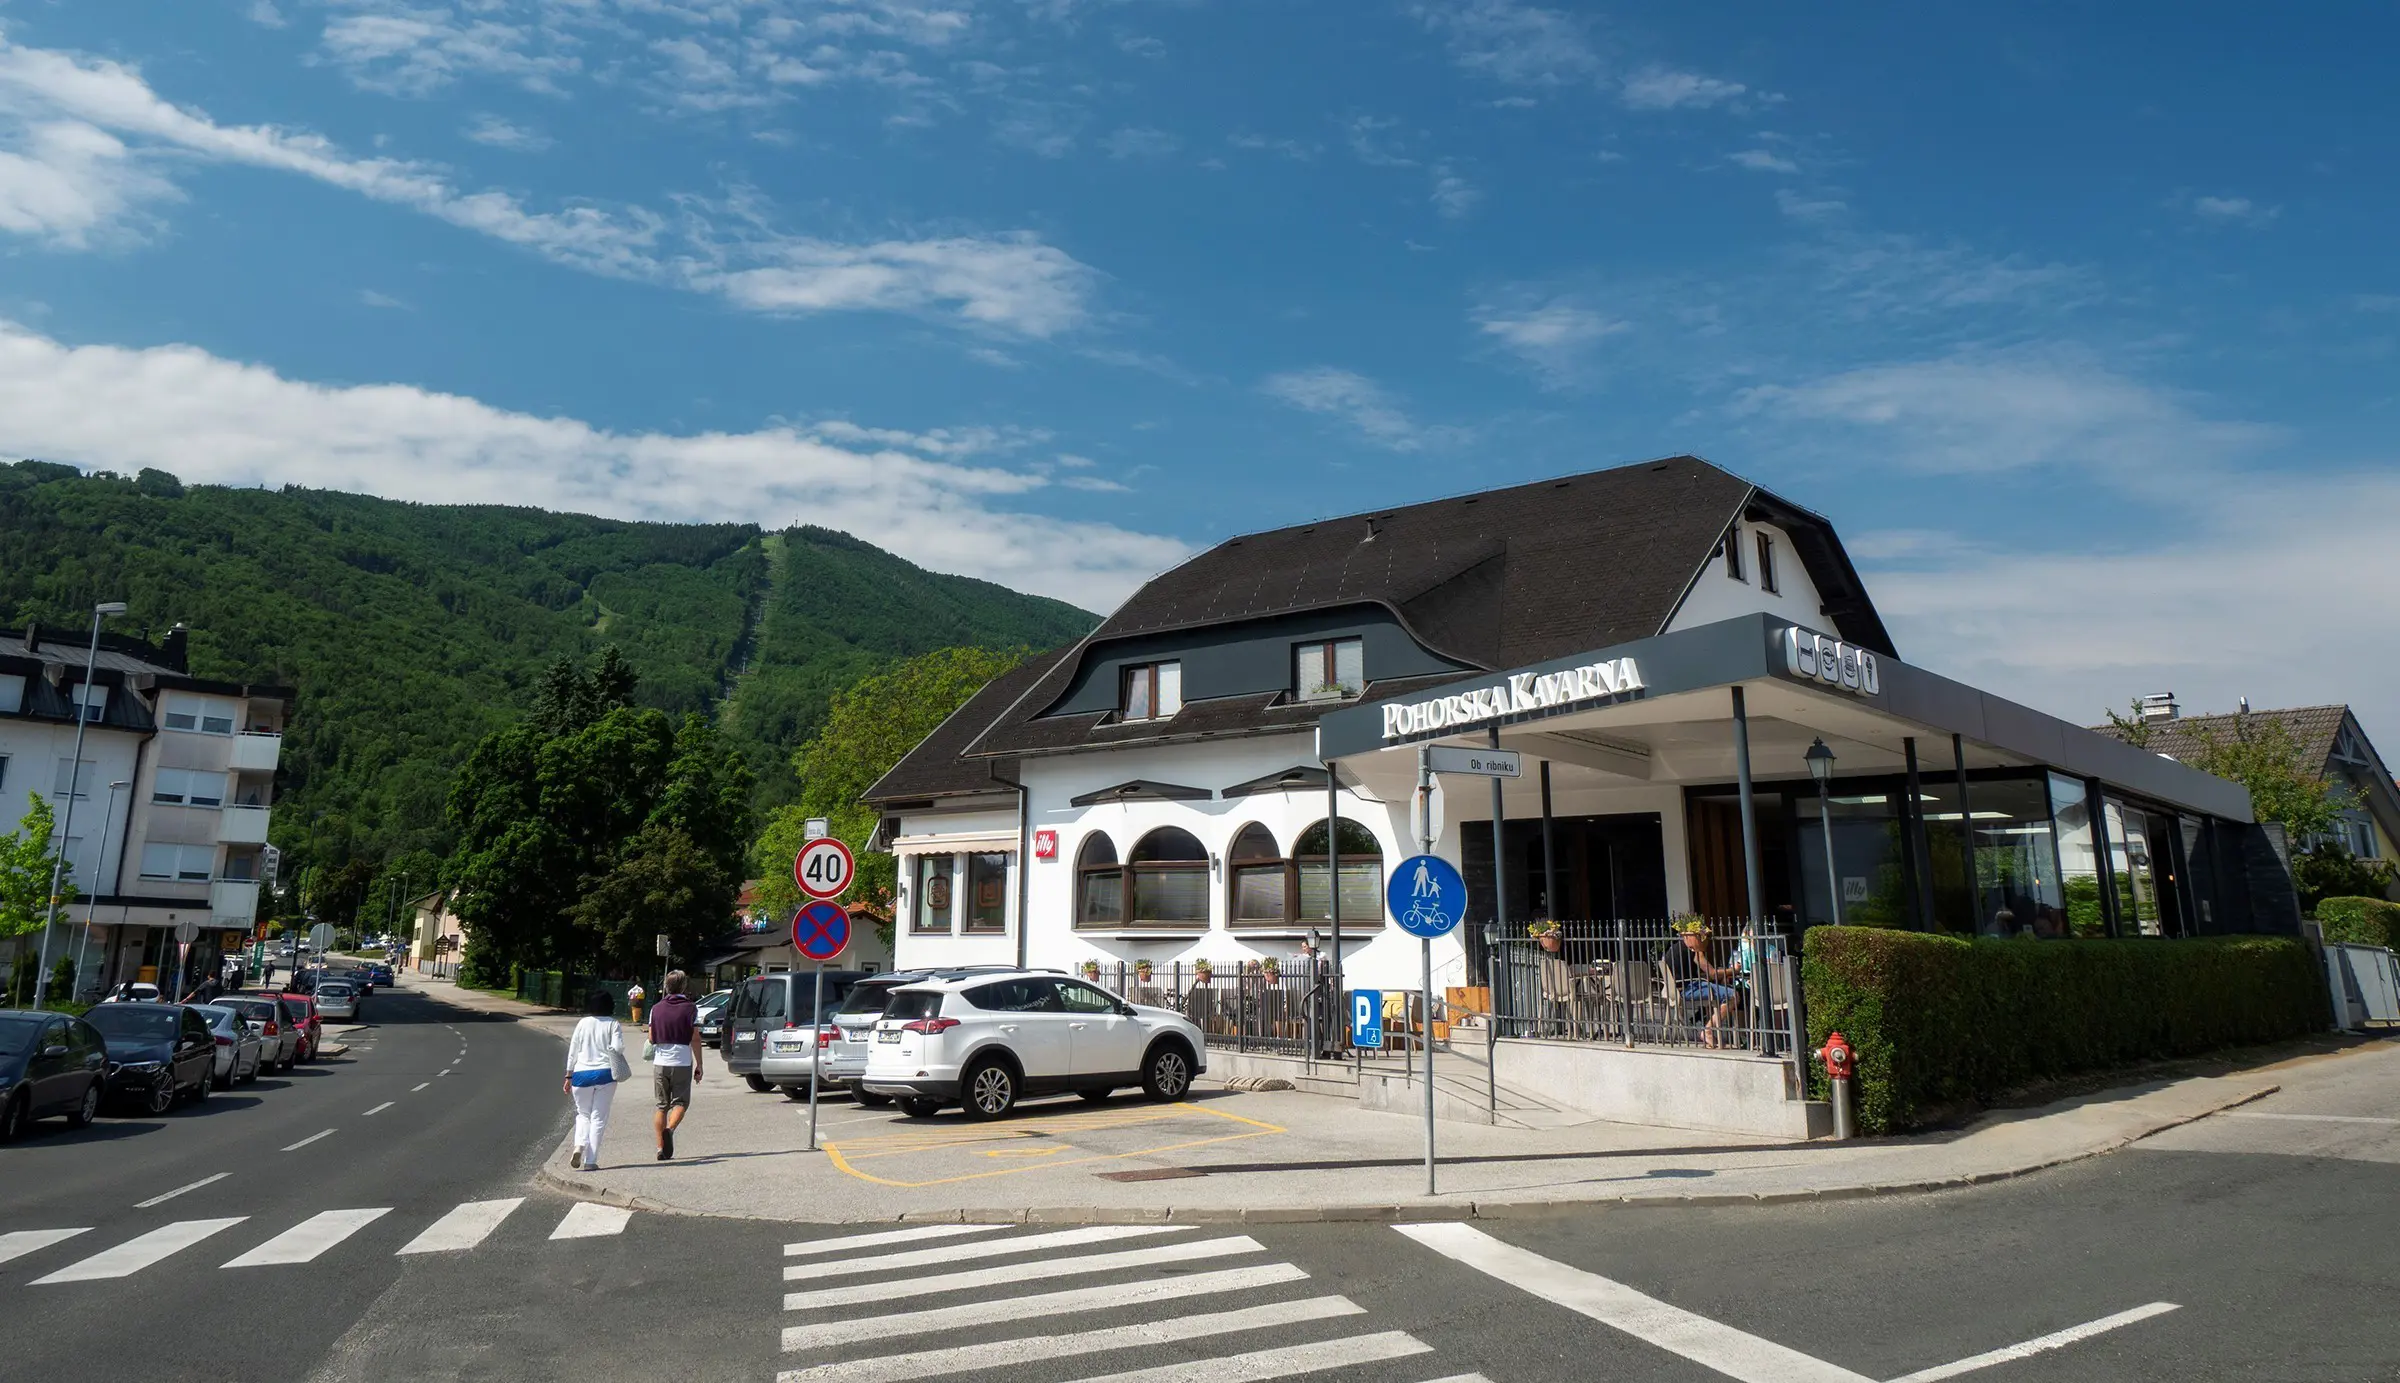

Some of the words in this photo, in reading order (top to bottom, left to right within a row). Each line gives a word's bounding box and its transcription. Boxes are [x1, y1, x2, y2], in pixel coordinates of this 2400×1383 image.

[1381, 686, 1511, 739] POHORSKA
[1504, 657, 1645, 714] KAVARNA
[1470, 758, 1482, 770] Ob
[1486, 760, 1514, 772] ribniku
[1036, 834, 1054, 856] illy
[805, 853, 841, 883] 40
[1845, 880, 1866, 900] illy
[1355, 995, 1371, 1036] P
